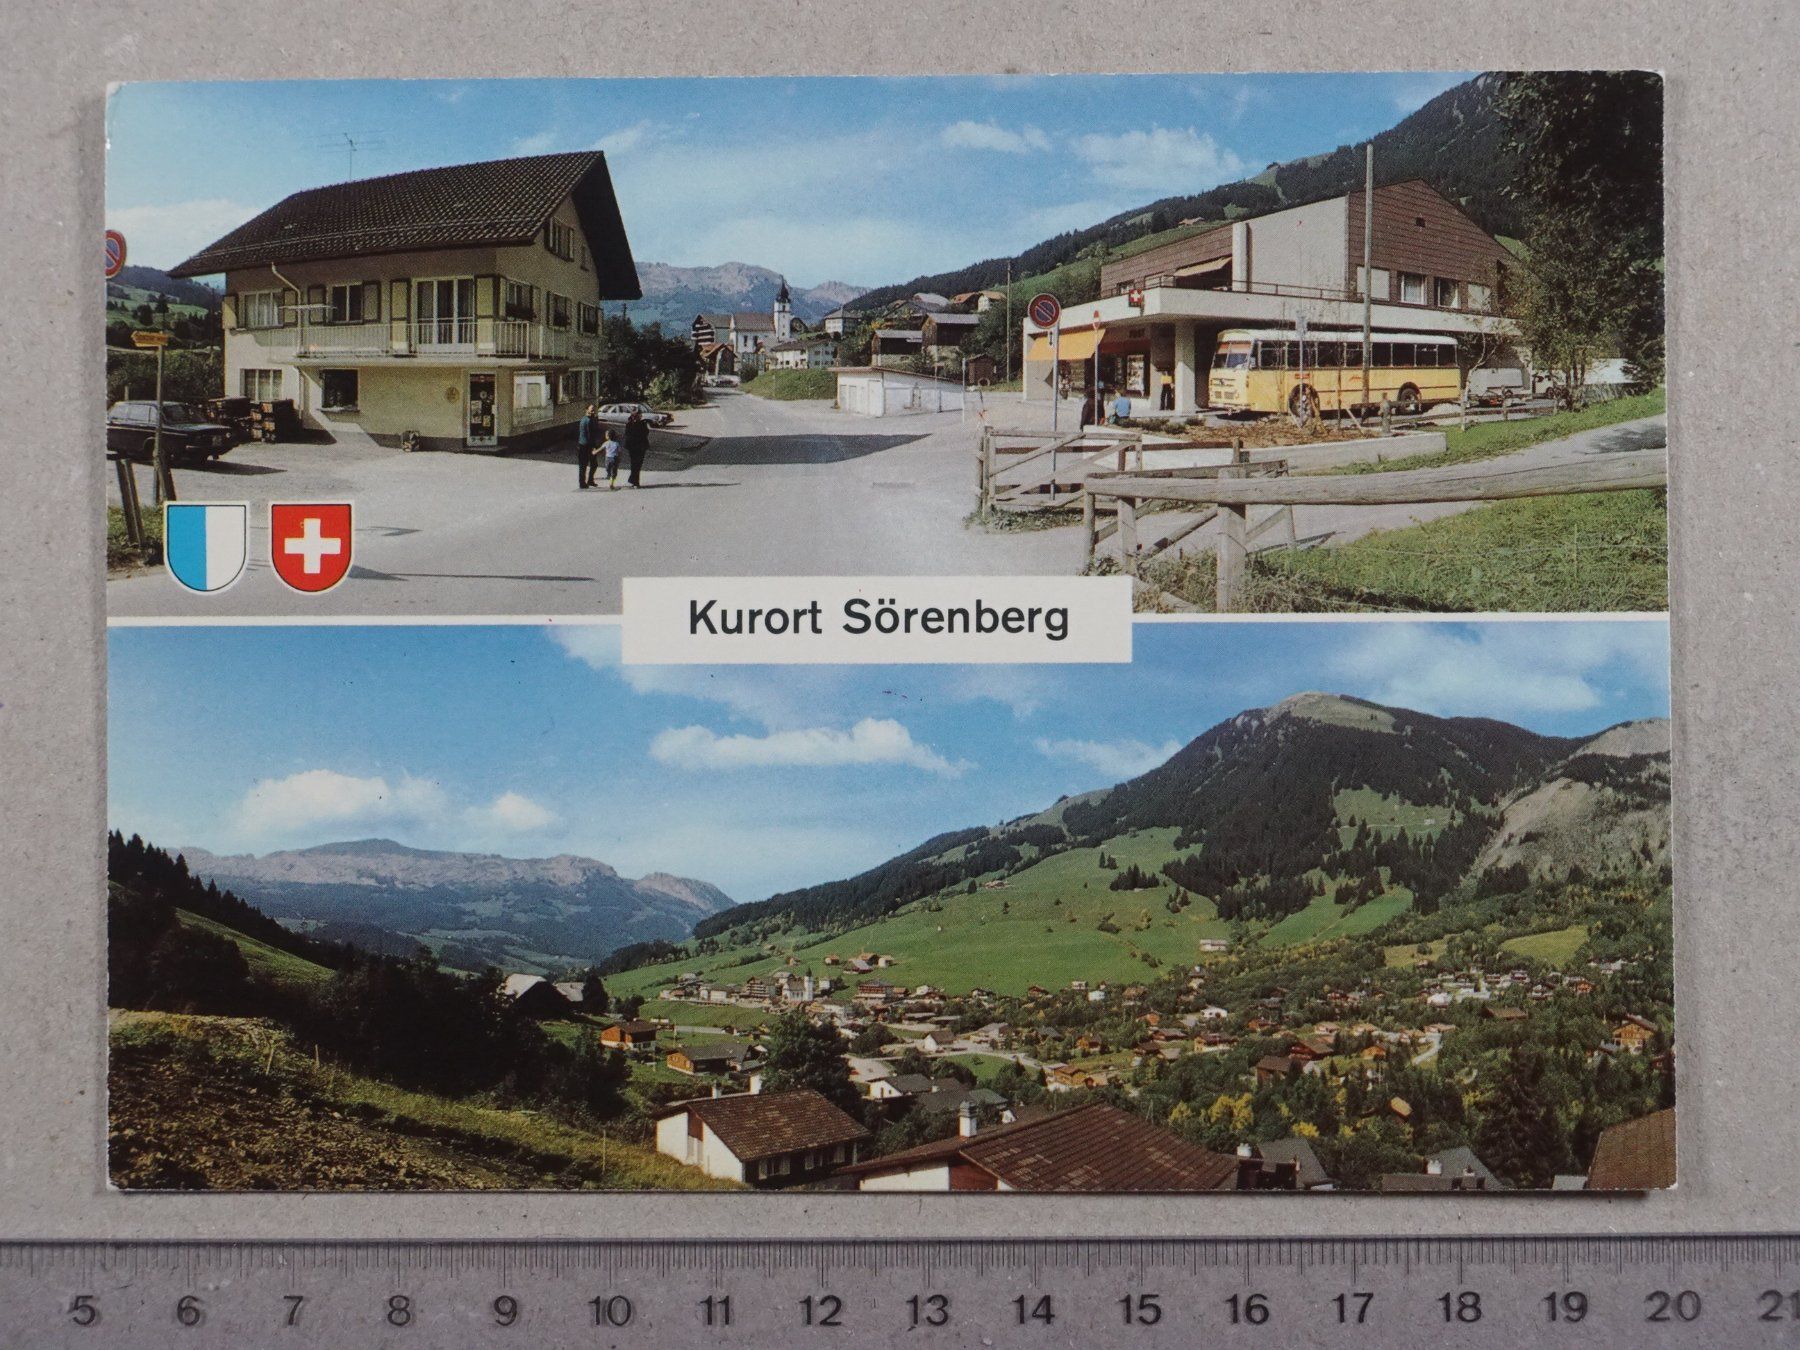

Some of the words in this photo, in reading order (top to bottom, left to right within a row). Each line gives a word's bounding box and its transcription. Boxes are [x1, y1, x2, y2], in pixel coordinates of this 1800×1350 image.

[690, 599, 822, 635] Kurort
[843, 598, 1069, 642] Sörenberg
[72, 1295, 98, 1329] 5
[175, 1295, 203, 1329] 6
[285, 1294, 306, 1328] 7
[387, 1294, 413, 1329] 8
[492, 1294, 519, 1329] 9
[589, 1294, 634, 1328] 10
[697, 1294, 731, 1328] 11
[800, 1294, 845, 1328] 12
[904, 1293, 951, 1328] 13
[1011, 1292, 1057, 1327] 14
[1117, 1292, 1163, 1327] 15
[1223, 1292, 1270, 1326] 16
[1330, 1291, 1374, 1326] 17
[1436, 1291, 1484, 1325] 18
[1542, 1291, 1590, 1325] 19
[1643, 1290, 1704, 1324] 20
